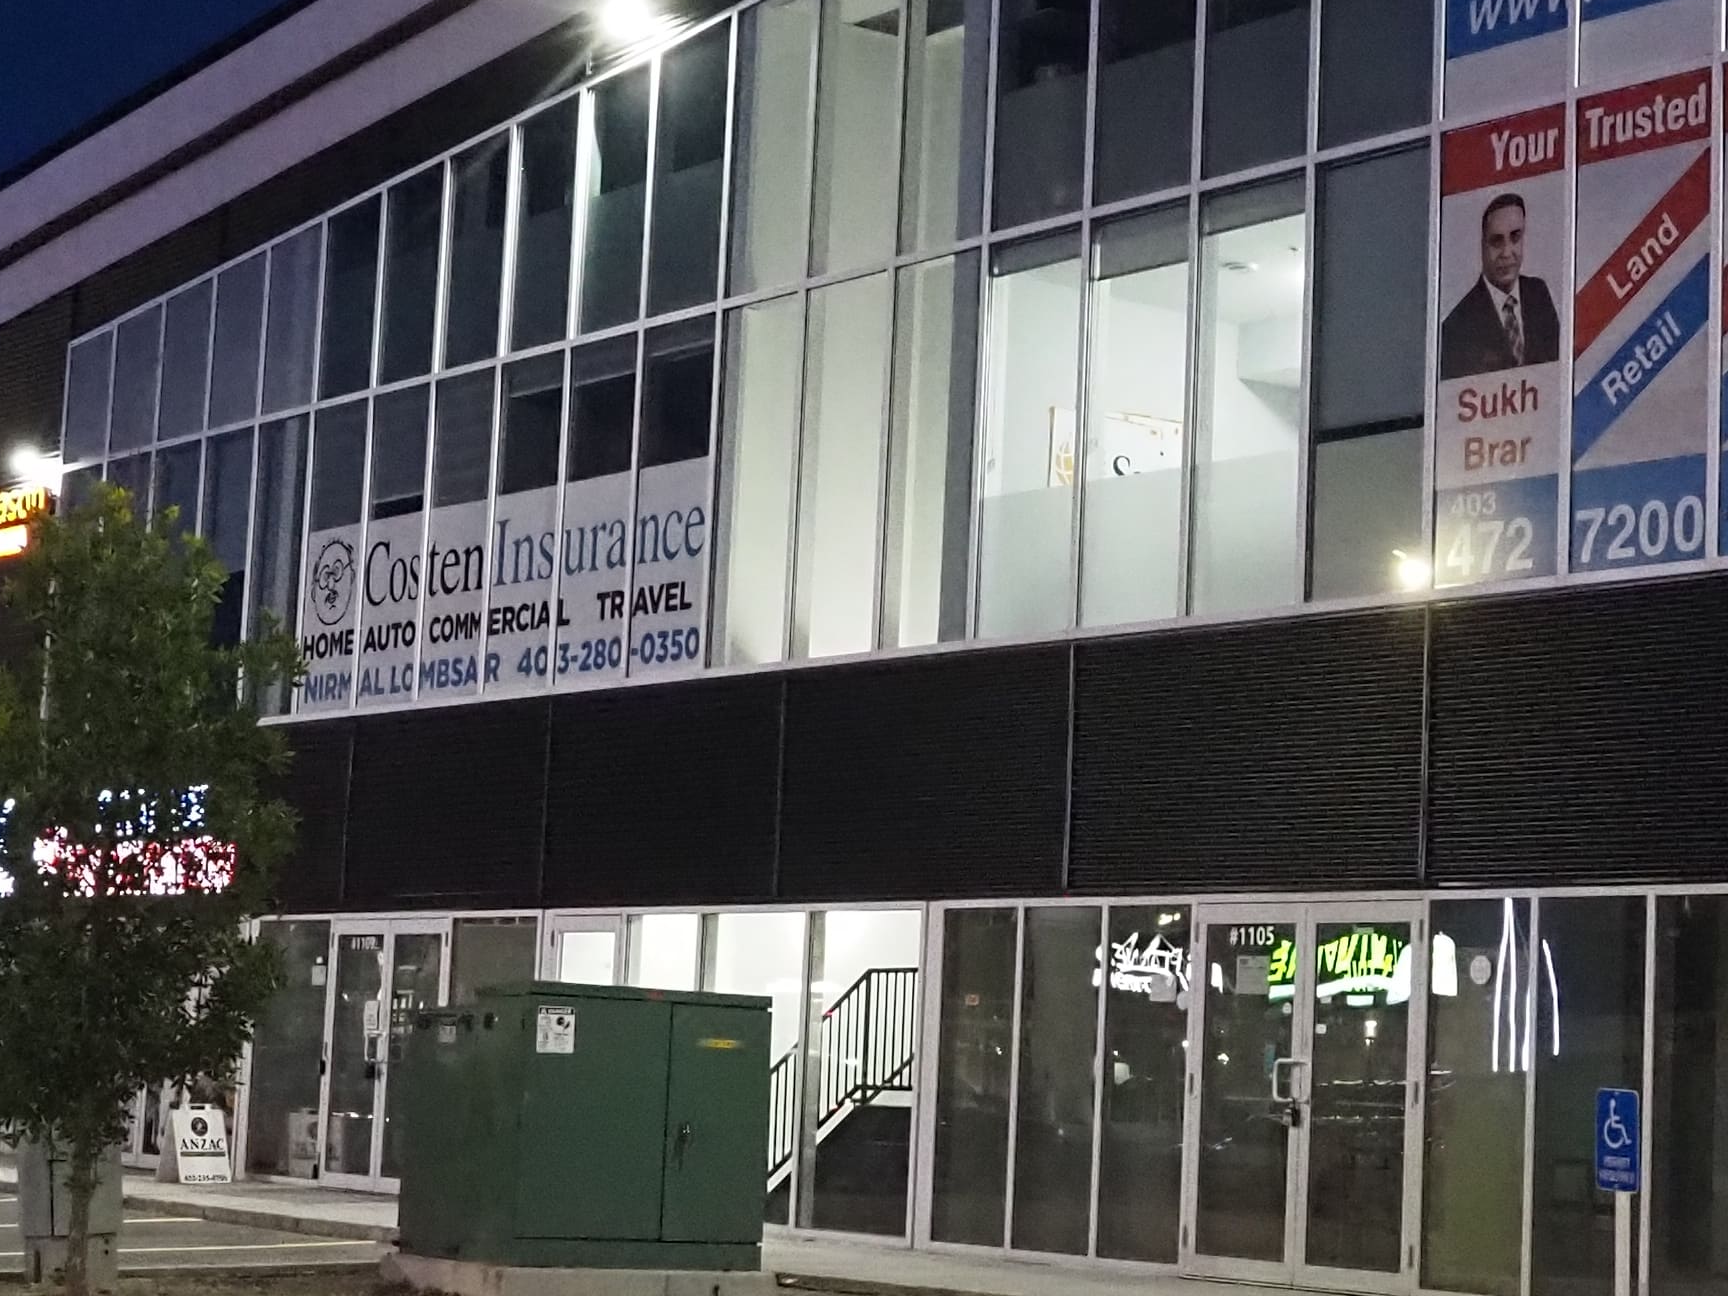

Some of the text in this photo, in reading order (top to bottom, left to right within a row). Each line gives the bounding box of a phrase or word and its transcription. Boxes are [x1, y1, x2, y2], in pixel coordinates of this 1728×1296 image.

[1489, 120, 1559, 171] Your
[1585, 83, 1707, 150] Trusted
[1605, 216, 1680, 300] Land
[1601, 314, 1683, 406] Retail
[1455, 380, 1540, 424] Sukh
[1462, 434, 1532, 472] Brar
[1446, 495, 1706, 577] 472 7200
[1449, 489, 1497, 516] 403
[365, 505, 706, 607] Costen Insurance
[302, 580, 693, 661] HOME AUTO COMMERCIAL TRAVEL
[303, 626, 701, 704] NIRMAL LOMBSAR 403-280-0350
[1228, 926, 1275, 947] #1105
[180, 1137, 225, 1151] ANZAC
